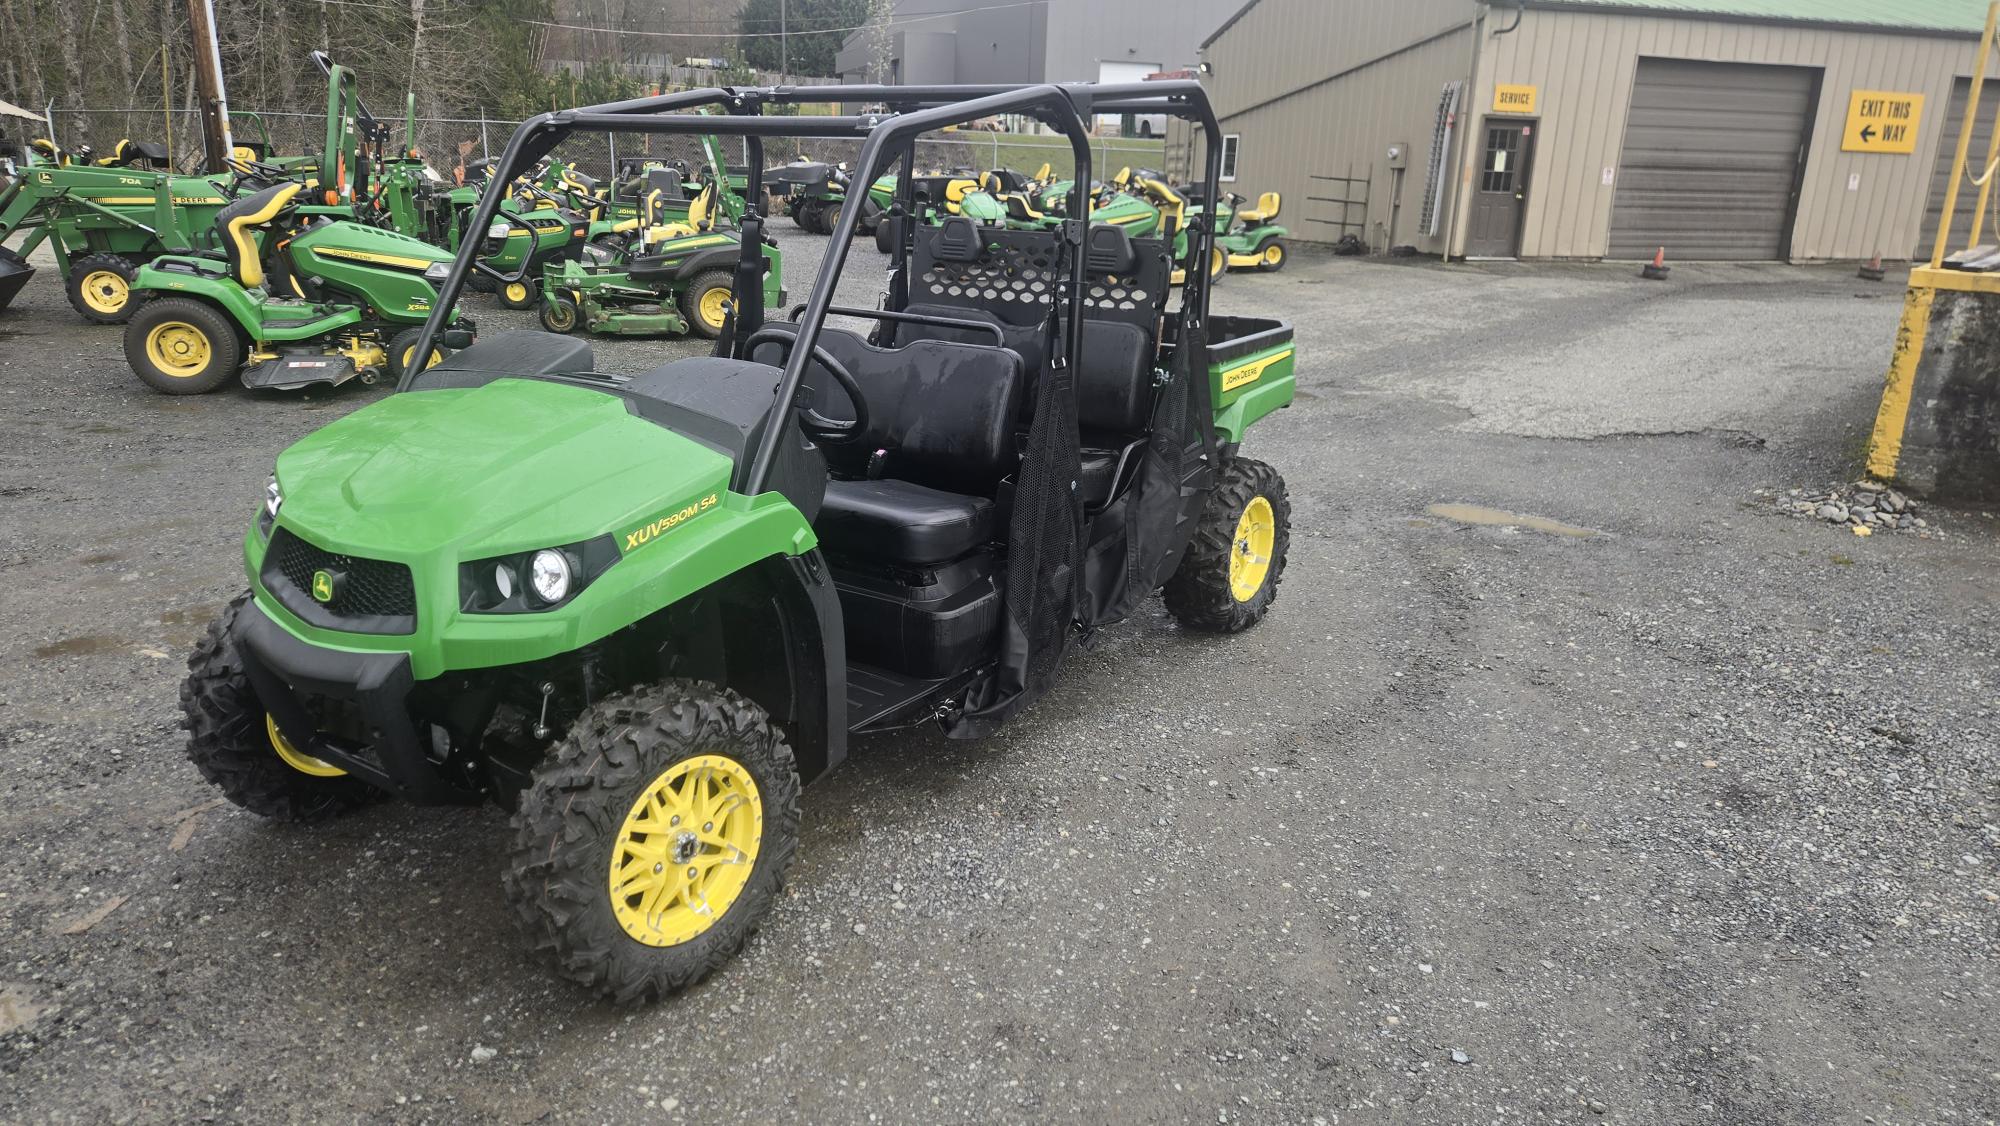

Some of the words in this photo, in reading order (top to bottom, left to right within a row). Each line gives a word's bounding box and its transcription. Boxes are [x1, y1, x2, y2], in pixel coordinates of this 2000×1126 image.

[1500, 92, 1530, 104] SERVICE
[1860, 99, 1884, 118] EXIT
[1888, 101, 1911, 119] THIS
[1882, 124, 1906, 142] WAY
[120, 178, 142, 186] 70A
[1226, 375, 1240, 385] JOHN
[1240, 367, 1258, 379] DEERE
[624, 502, 698, 552] XUV590M
[700, 494, 718, 510] S4
